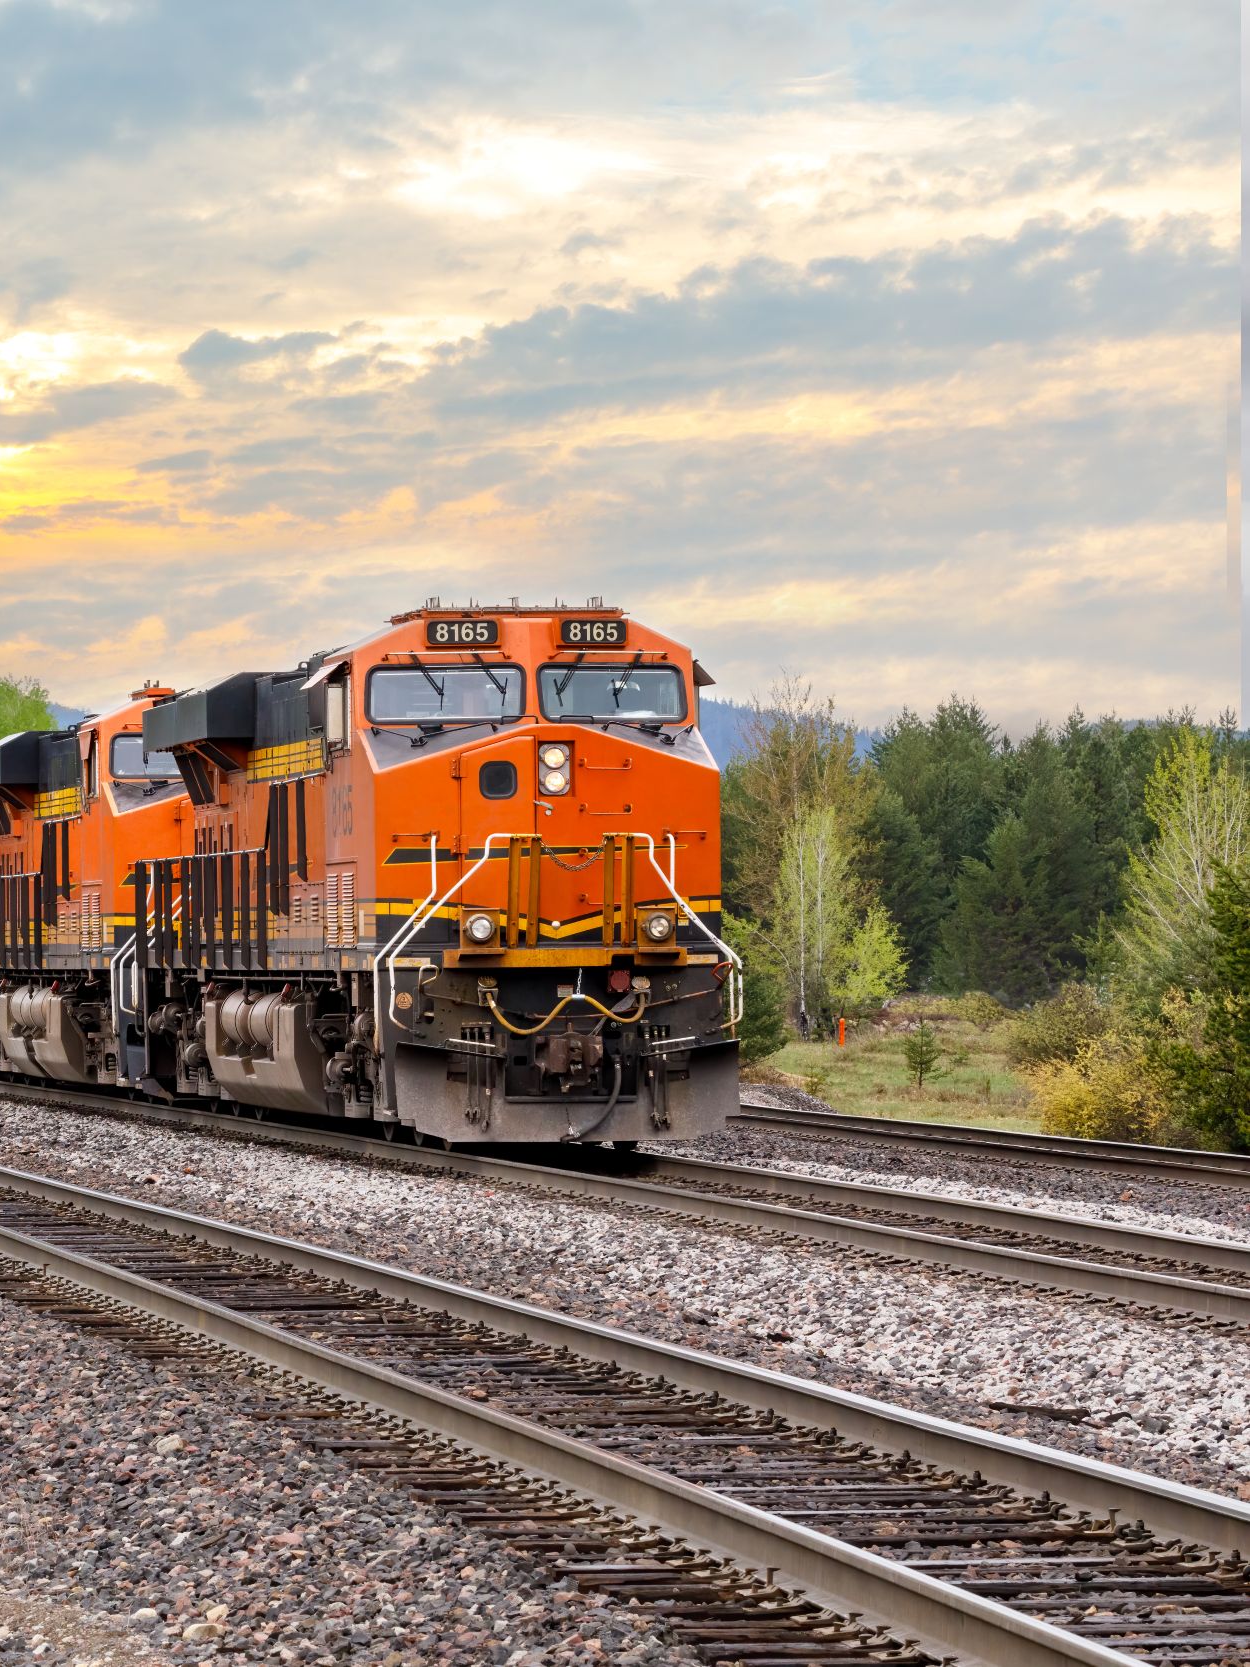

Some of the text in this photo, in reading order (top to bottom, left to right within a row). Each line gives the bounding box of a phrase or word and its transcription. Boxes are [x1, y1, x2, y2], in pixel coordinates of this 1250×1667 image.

[435, 622, 489, 642] 8165
[569, 622, 618, 642] 8165
[331, 784, 353, 838] 8165
